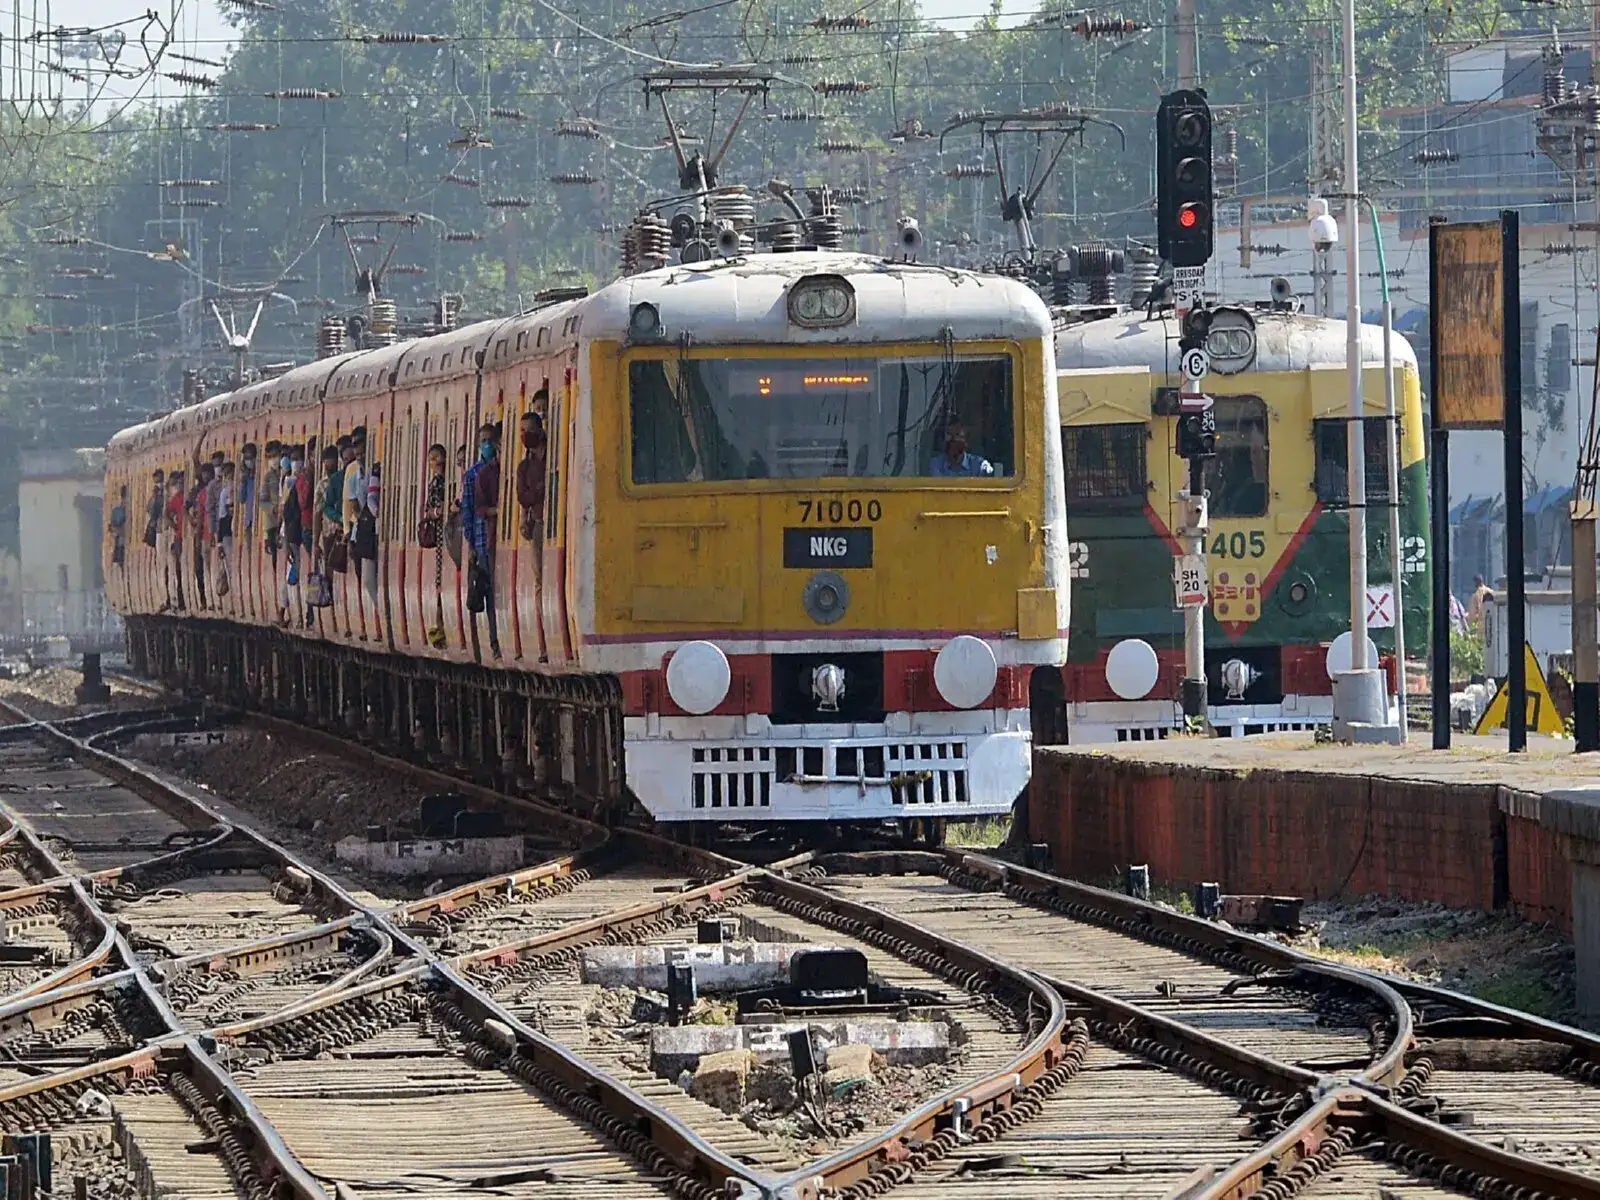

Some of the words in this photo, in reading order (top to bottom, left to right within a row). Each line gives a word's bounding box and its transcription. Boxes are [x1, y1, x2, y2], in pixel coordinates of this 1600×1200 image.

[1203, 410, 1214, 420] SH
[1202, 418, 1215, 431] 20
[798, 500, 882, 523] 71000
[810, 536, 847, 556] NKG
[1182, 570, 1199, 580] SH
[1183, 581, 1199, 592] 20
